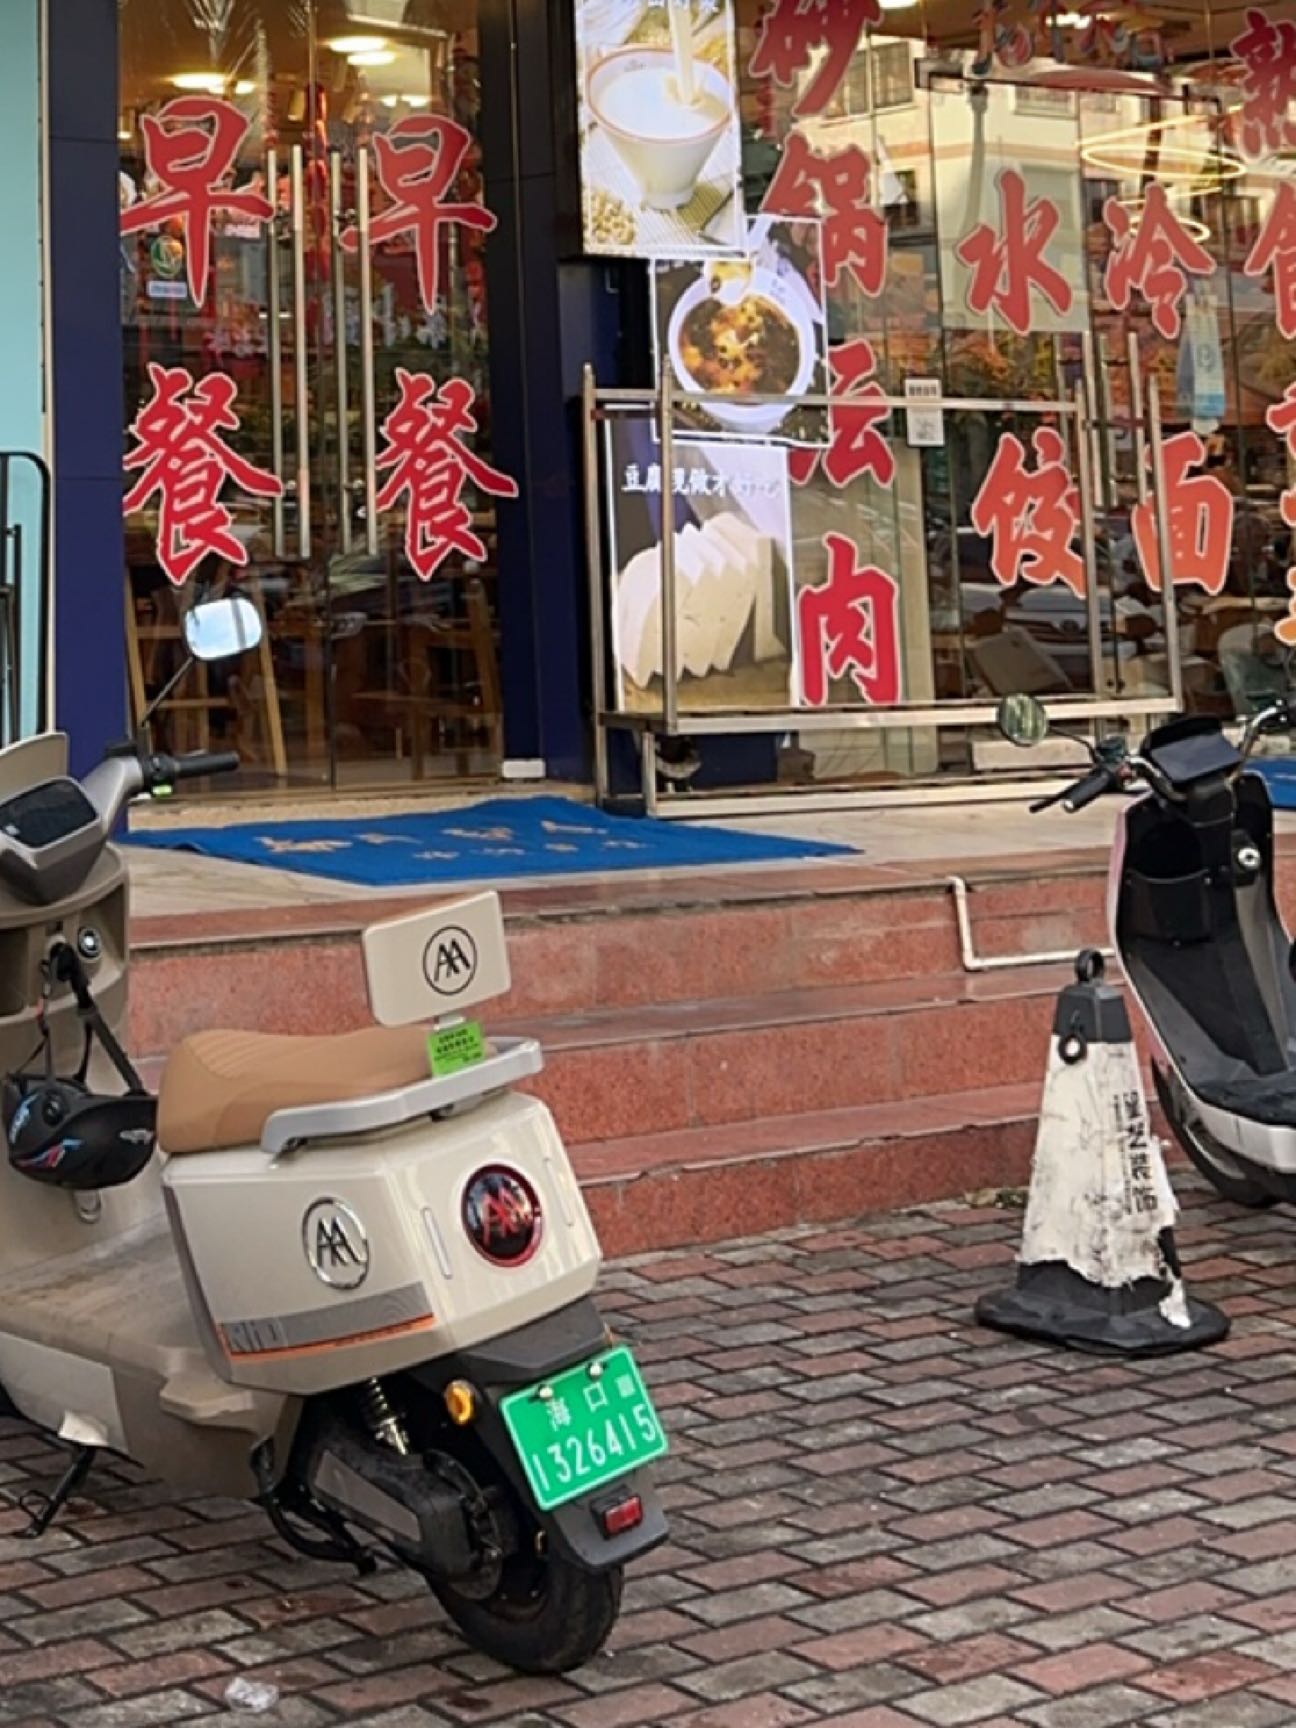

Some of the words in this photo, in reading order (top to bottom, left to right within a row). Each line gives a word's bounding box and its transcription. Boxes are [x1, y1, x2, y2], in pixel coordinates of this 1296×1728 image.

[119, 93, 284, 586] 早餐
[341, 112, 519, 584] 早餐
[958, 167, 1090, 599] 水饺
[1104, 183, 1235, 596] 冷面
[531, 1402, 656, 1492] 1326415
